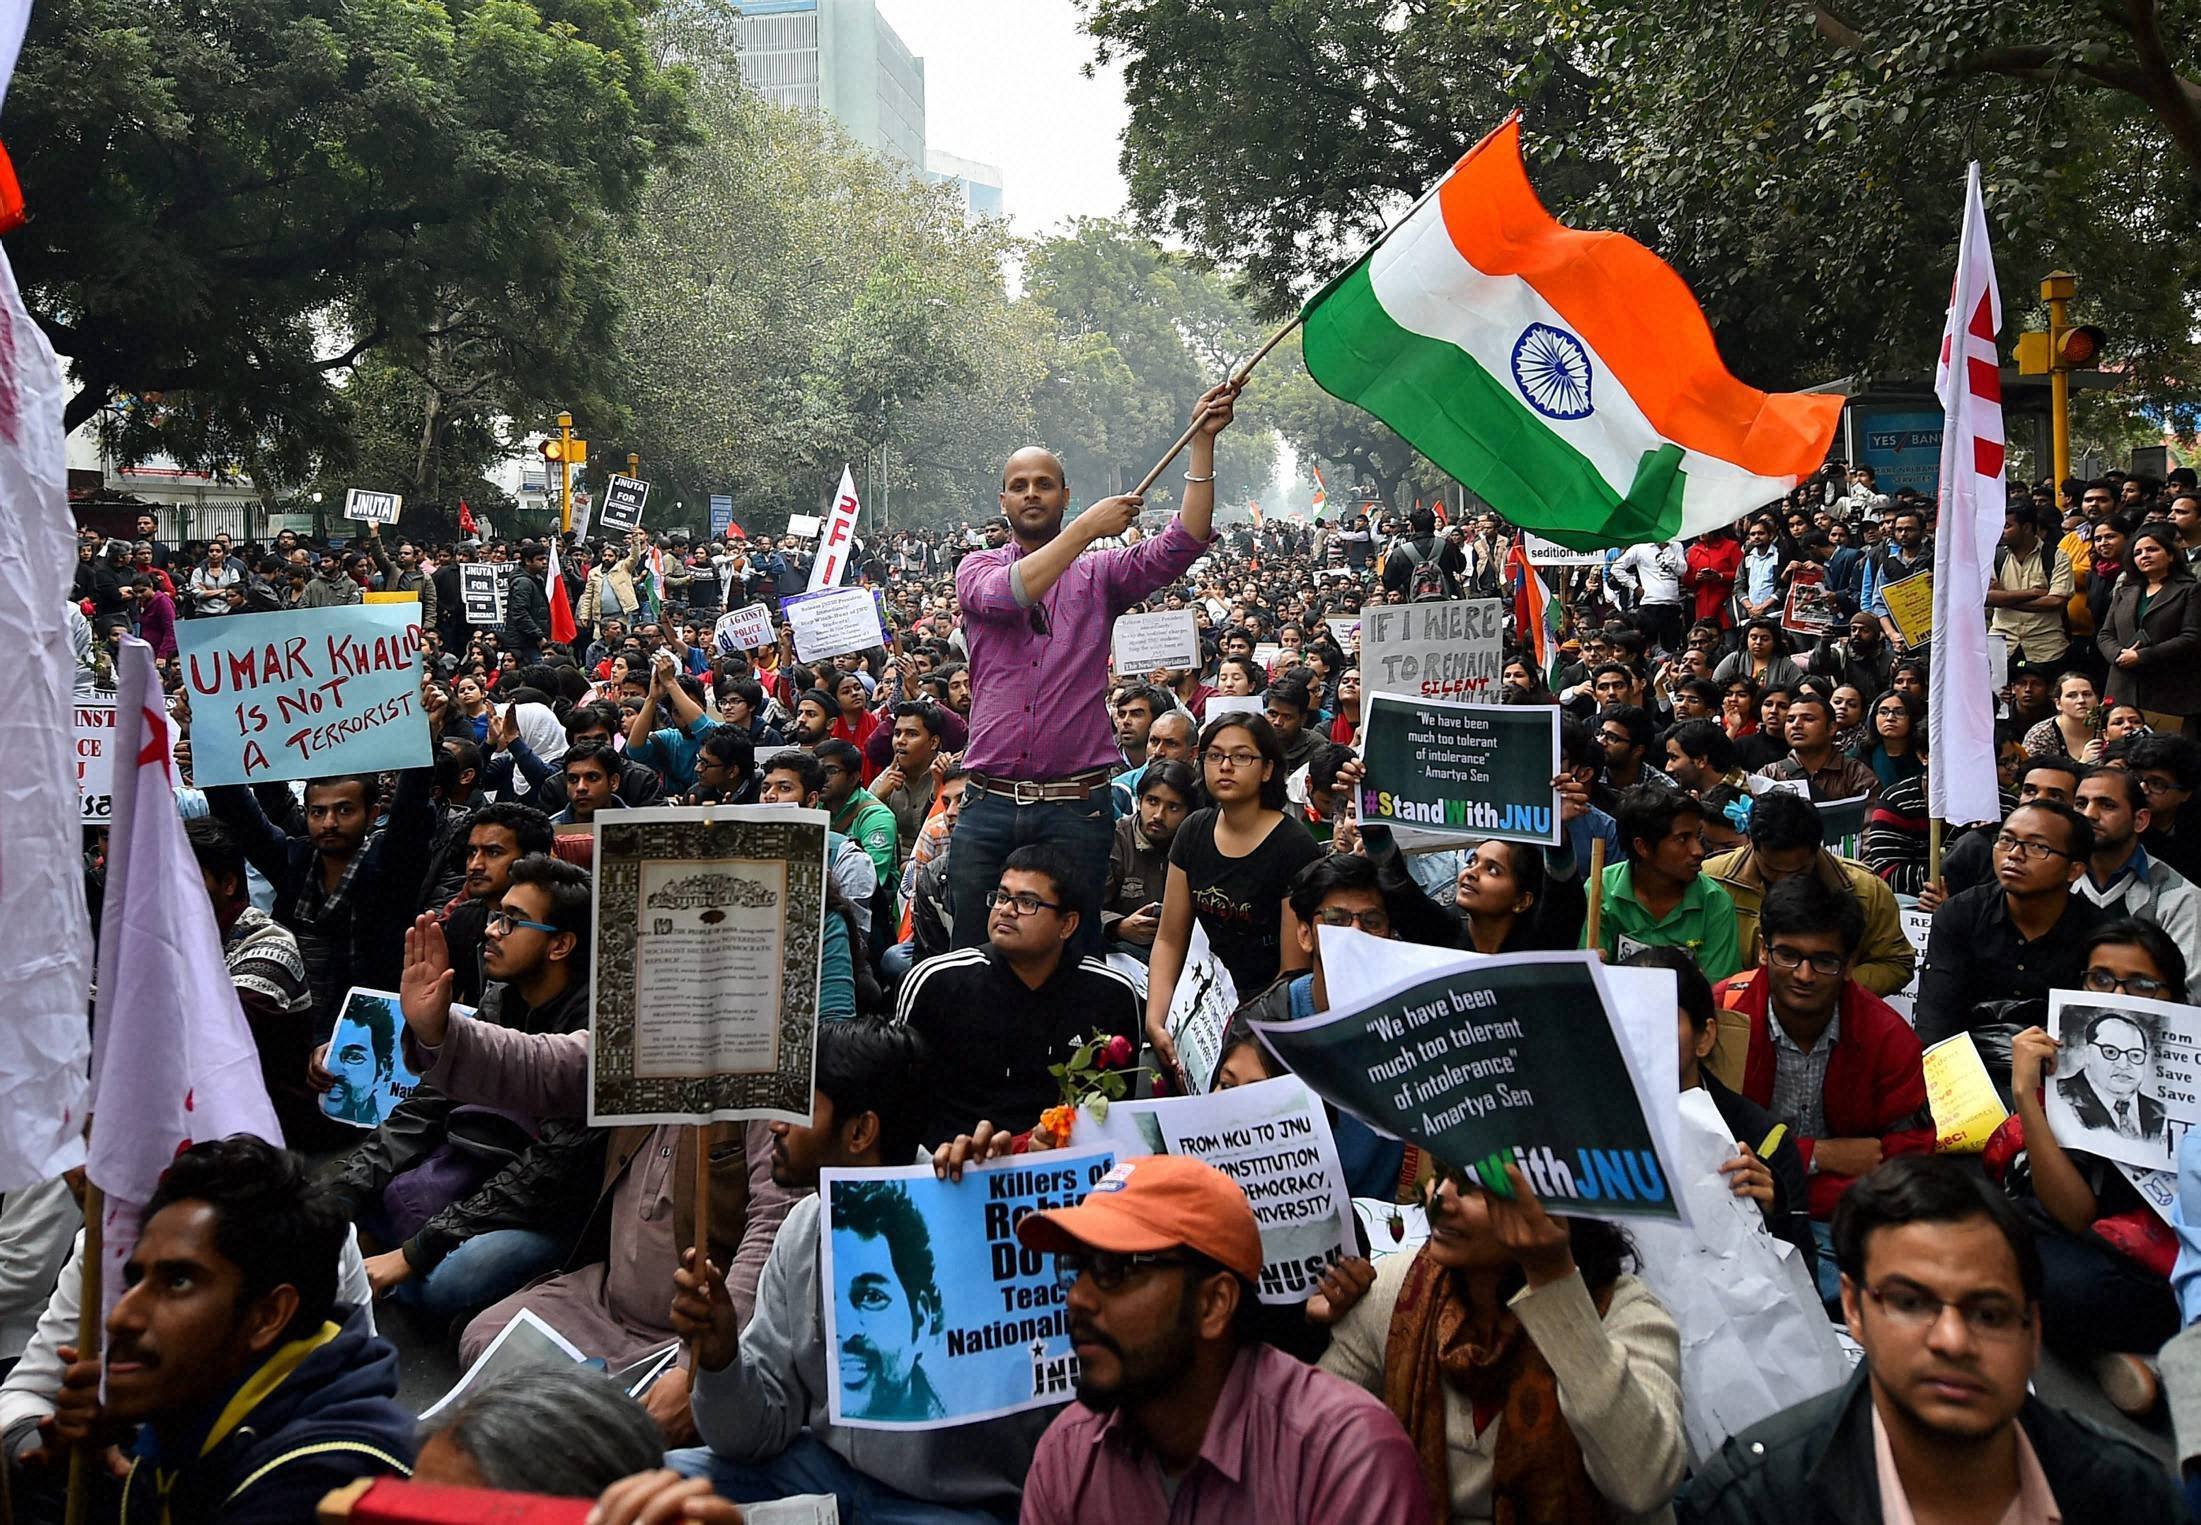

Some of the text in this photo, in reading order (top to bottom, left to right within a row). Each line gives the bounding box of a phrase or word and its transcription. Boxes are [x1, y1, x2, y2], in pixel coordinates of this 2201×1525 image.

[1873, 435, 1898, 447] YES
[615, 478, 644, 492] JNUTA
[353, 494, 391, 517] JNUTA
[616, 491, 636, 503] FOR
[1531, 547, 1573, 558] sedition
[465, 566, 492, 576] JNUTA
[471, 580, 489, 590] FOR
[729, 609, 763, 626] AGAINST
[1370, 612, 1394, 643] IF
[1402, 610, 1411, 641] I
[1424, 603, 1496, 641] WERE
[733, 623, 762, 638] POLICE
[743, 635, 759, 646] RAJ
[190, 623, 423, 695] UMAR KHALID
[1126, 662, 1139, 671] The
[1381, 650, 1500, 684] TO REMAIN
[1420, 677, 1489, 694] SILENT
[234, 675, 350, 737] IS NOT
[1437, 713, 1462, 729] have
[1463, 716, 1489, 730] been
[242, 690, 414, 777] A TERRORIST
[1408, 732, 1498, 748] much too tolerant
[1415, 749, 1427, 761] of
[1425, 765, 1468, 782] Amartya
[1469, 769, 1490, 783] Sen
[1363, 789, 1551, 834] #StandWithJNU
[1402, 998, 1450, 1030] have
[1448, 987, 1498, 1013] been
[1367, 1016, 1525, 1084] much too tolerant
[2154, 1046, 2189, 1064] Save
[2156, 1065, 2193, 1084] Save
[1393, 1082, 1412, 1112] of
[2157, 1084, 2197, 1104] Save
[1421, 1092, 1497, 1137] Amartya
[1495, 1082, 1534, 1108] Sen
[1179, 1116, 1312, 1155] FROM HCU TO JNU
[989, 1169, 1077, 1201] Killers
[1088, 1158, 1113, 1187] of
